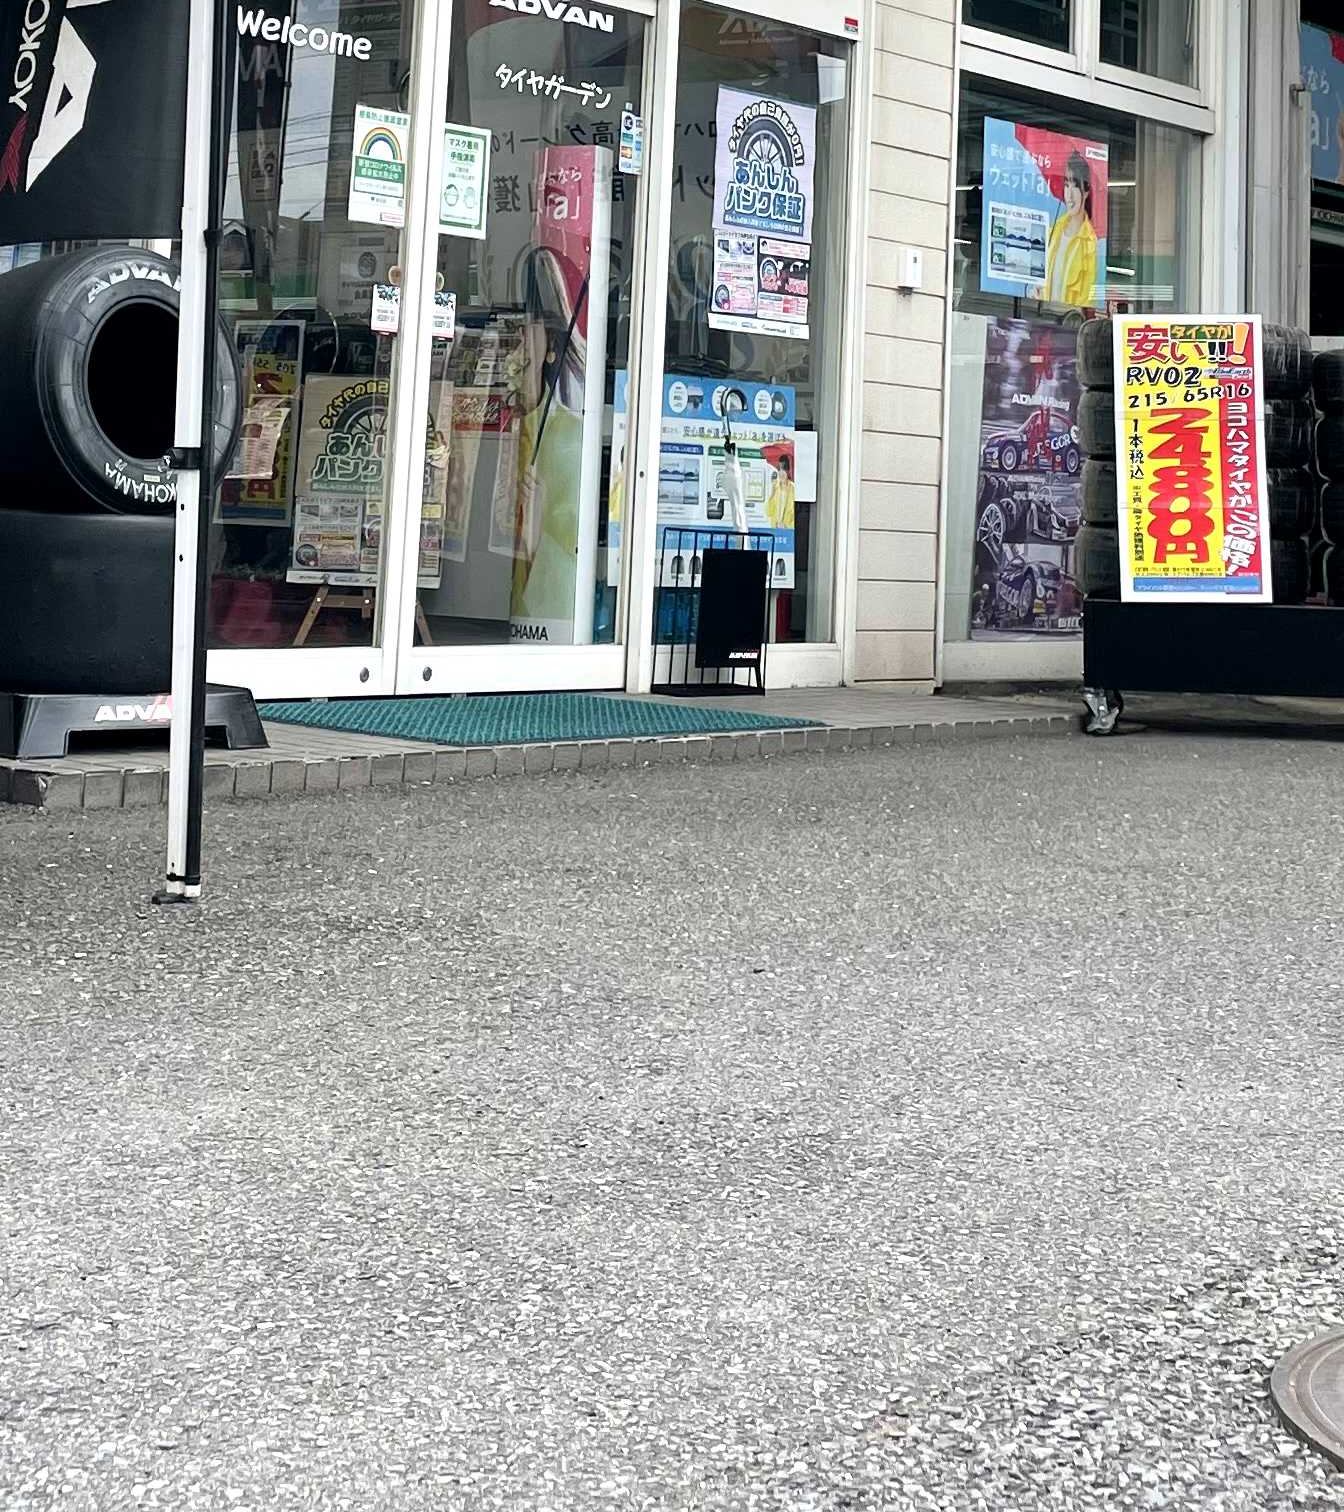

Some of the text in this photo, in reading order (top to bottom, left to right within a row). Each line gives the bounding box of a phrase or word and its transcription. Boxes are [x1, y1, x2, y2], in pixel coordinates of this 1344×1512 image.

[236, 4, 373, 61] Welcome
[494, 63, 612, 109] タイヤガーデン
[735, 159, 799, 194] あんしん
[725, 185, 804, 222] パンク保証
